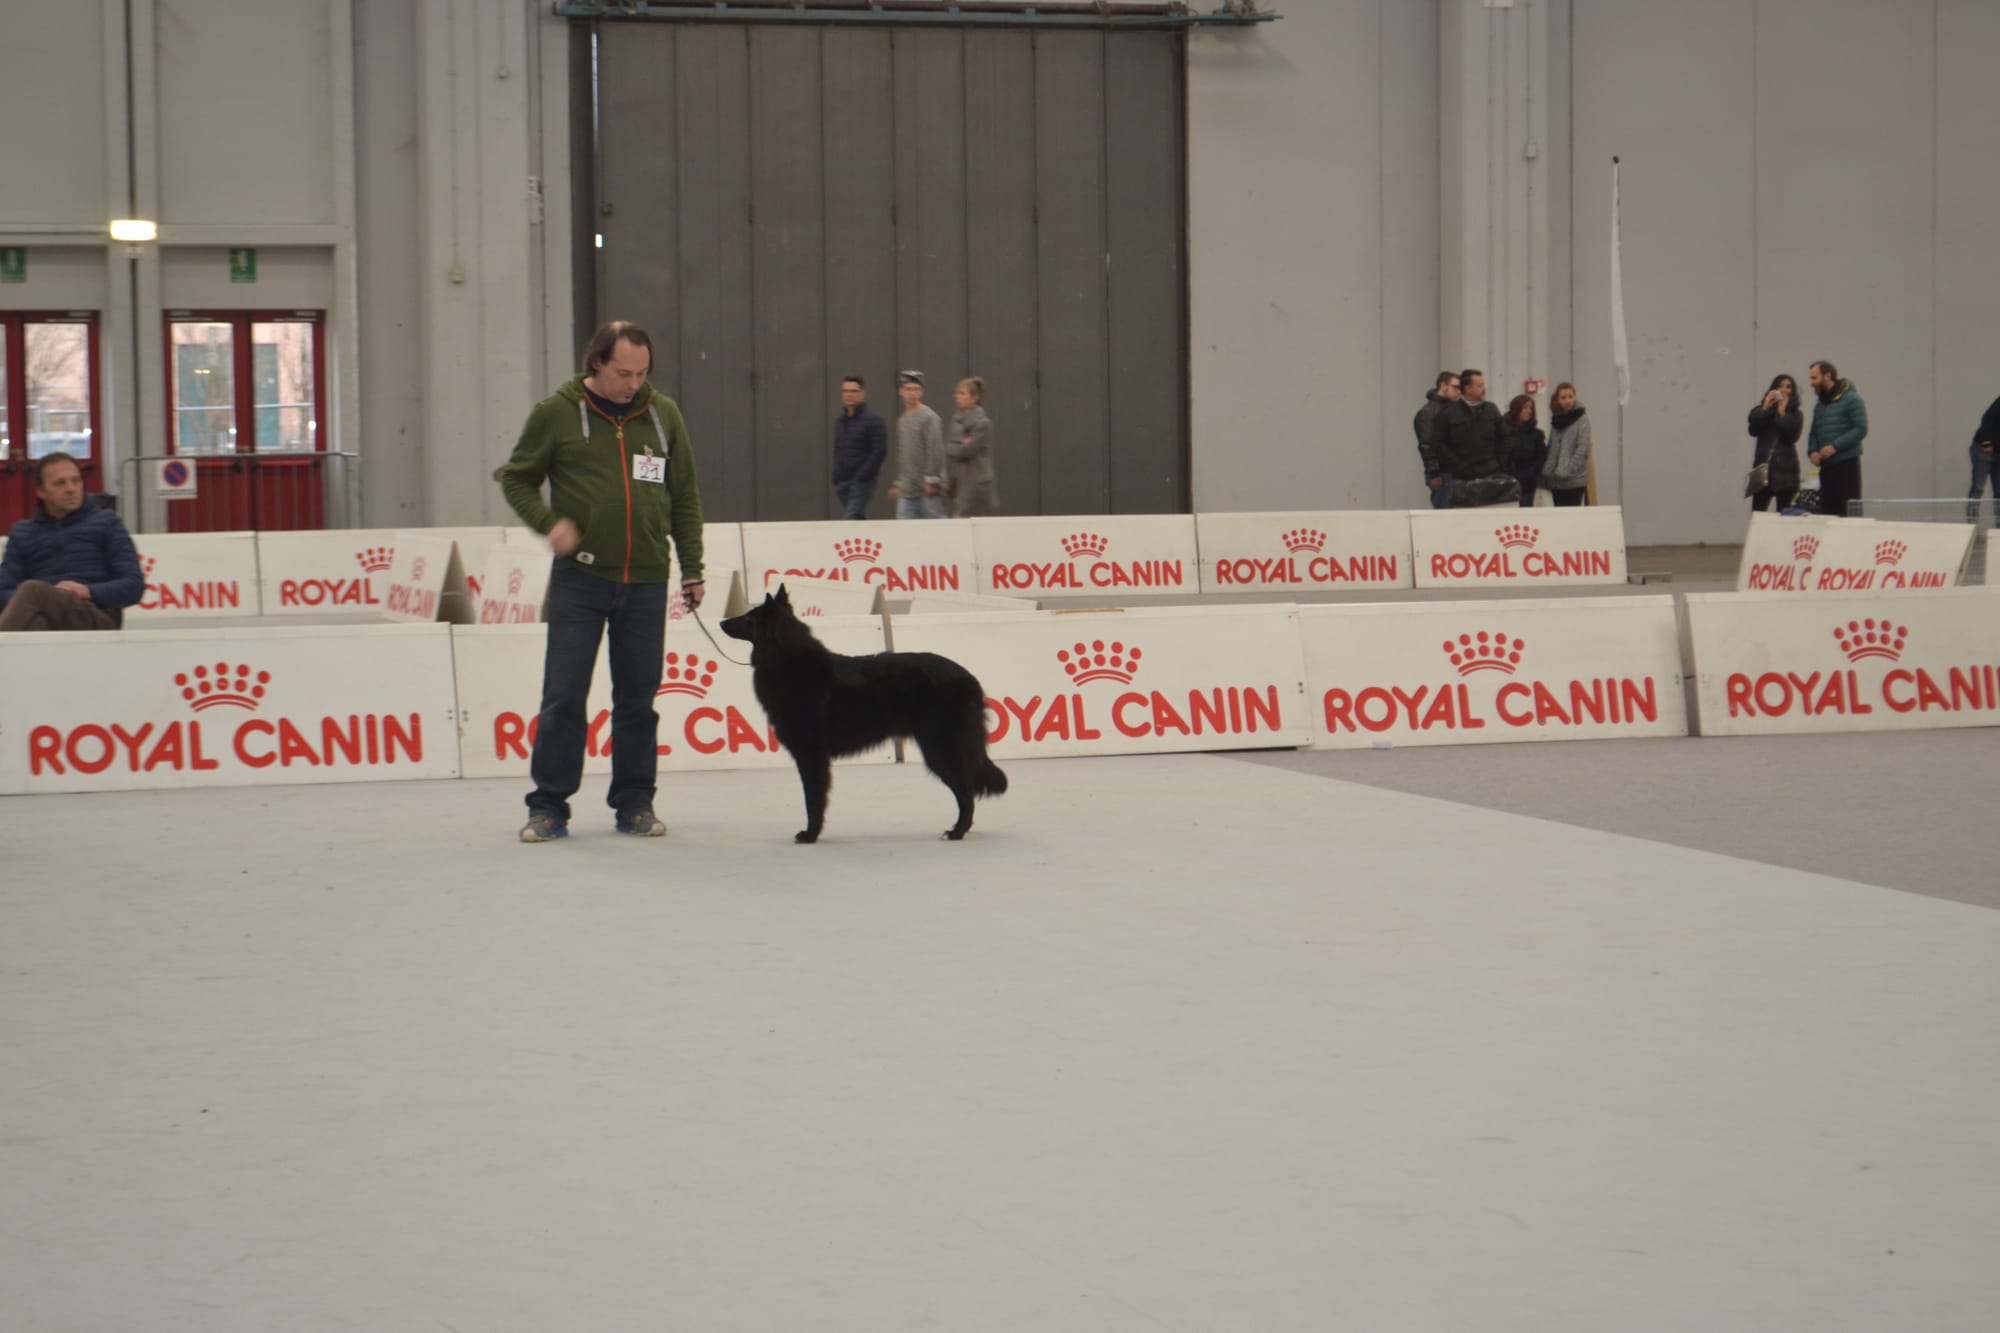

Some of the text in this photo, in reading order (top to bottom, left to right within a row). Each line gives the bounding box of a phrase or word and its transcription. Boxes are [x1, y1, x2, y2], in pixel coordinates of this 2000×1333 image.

[991, 558, 1184, 591] ROYAL CANIN
[1215, 553, 1398, 586] ROYAL CANIN
[1429, 549, 1612, 580] ROYAL CANIN
[1747, 562, 1797, 593] ROYAL
[137, 579, 241, 612] CANIN
[279, 577, 382, 608] ROYAL
[1322, 676, 1659, 736] ROYAL CANIN
[1724, 663, 2000, 719] ROYAL CANI
[983, 684, 1283, 747] OYAL CANIN
[28, 719, 220, 777] ROYAL
[232, 711, 425, 769] CANIN
